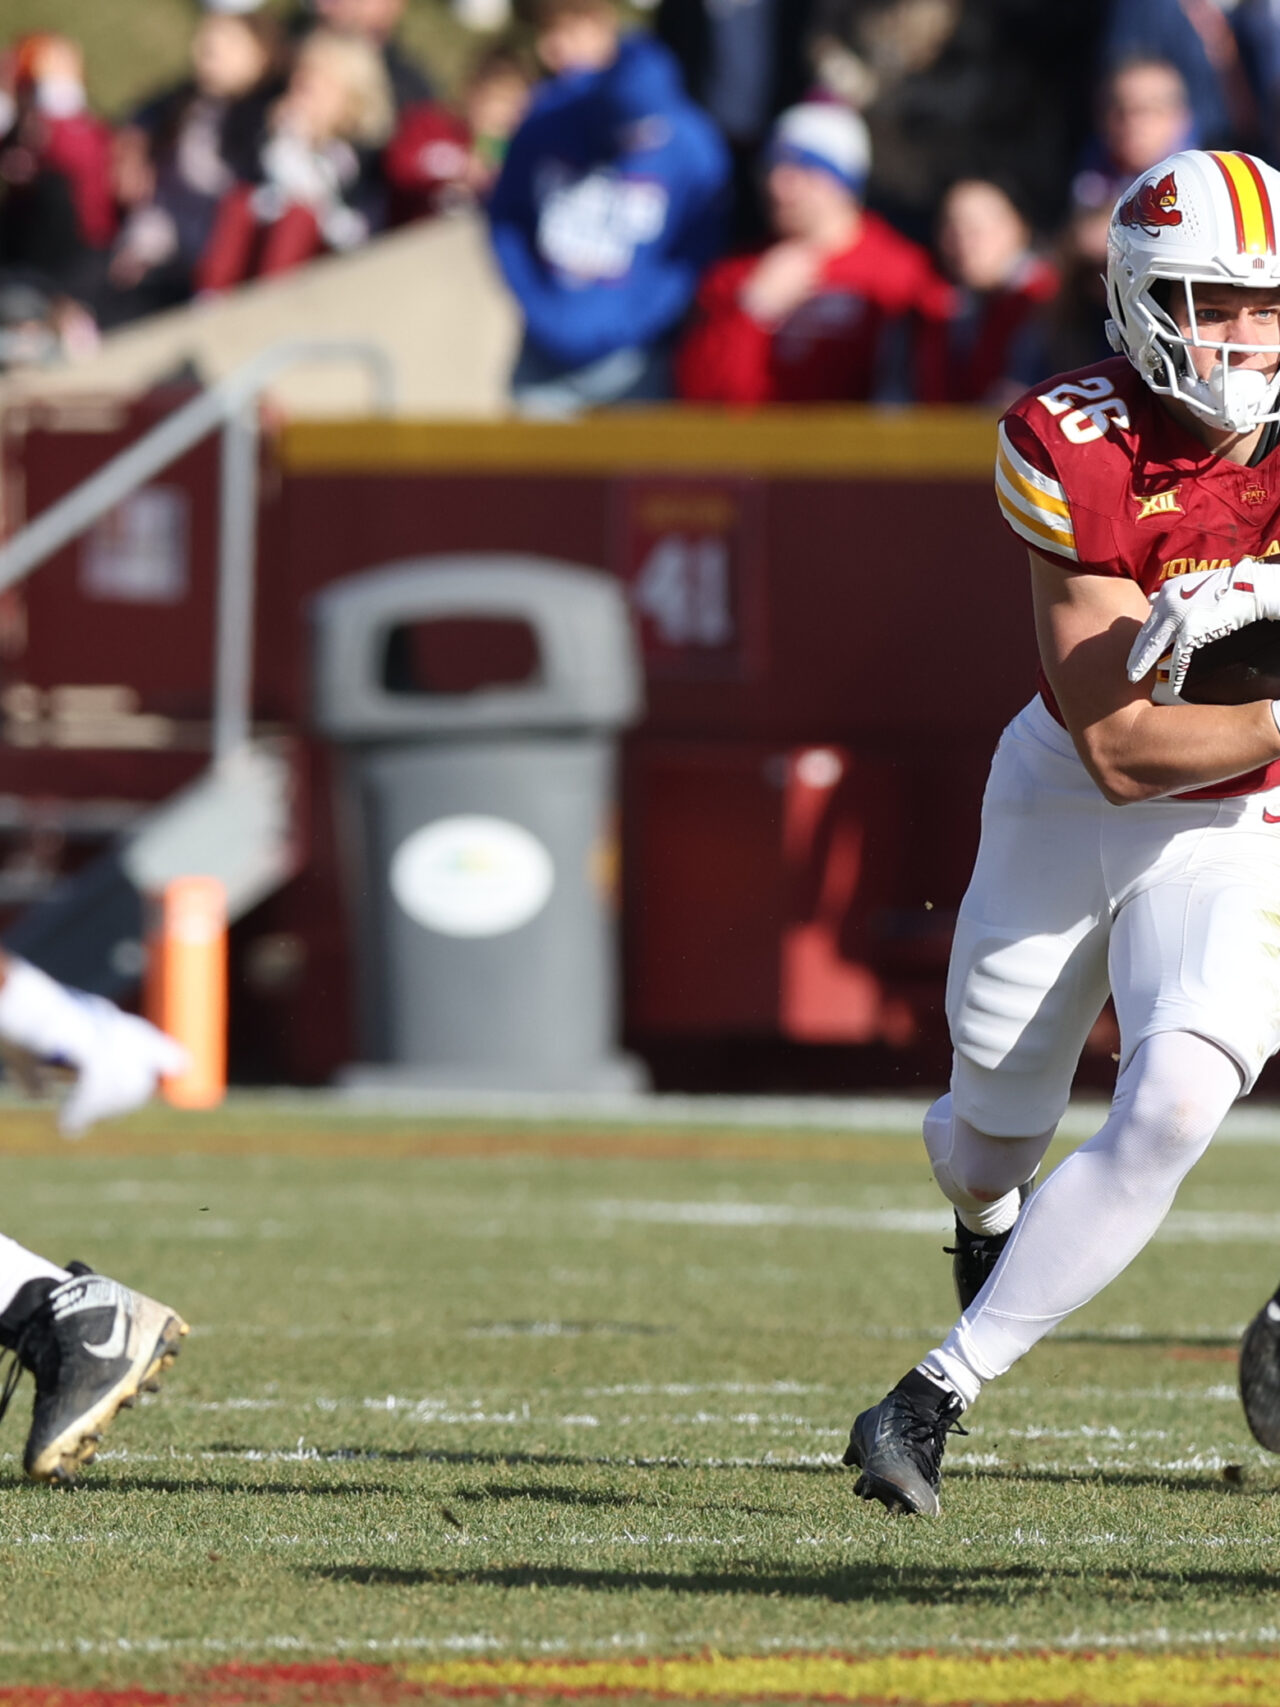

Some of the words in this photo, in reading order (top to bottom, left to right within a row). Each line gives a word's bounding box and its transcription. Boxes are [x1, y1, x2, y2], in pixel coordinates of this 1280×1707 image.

[1036, 377, 1130, 444] 26
[1134, 488, 1183, 520] XII
[1240, 490, 1267, 504] STATE
[636, 536, 732, 647] 41
